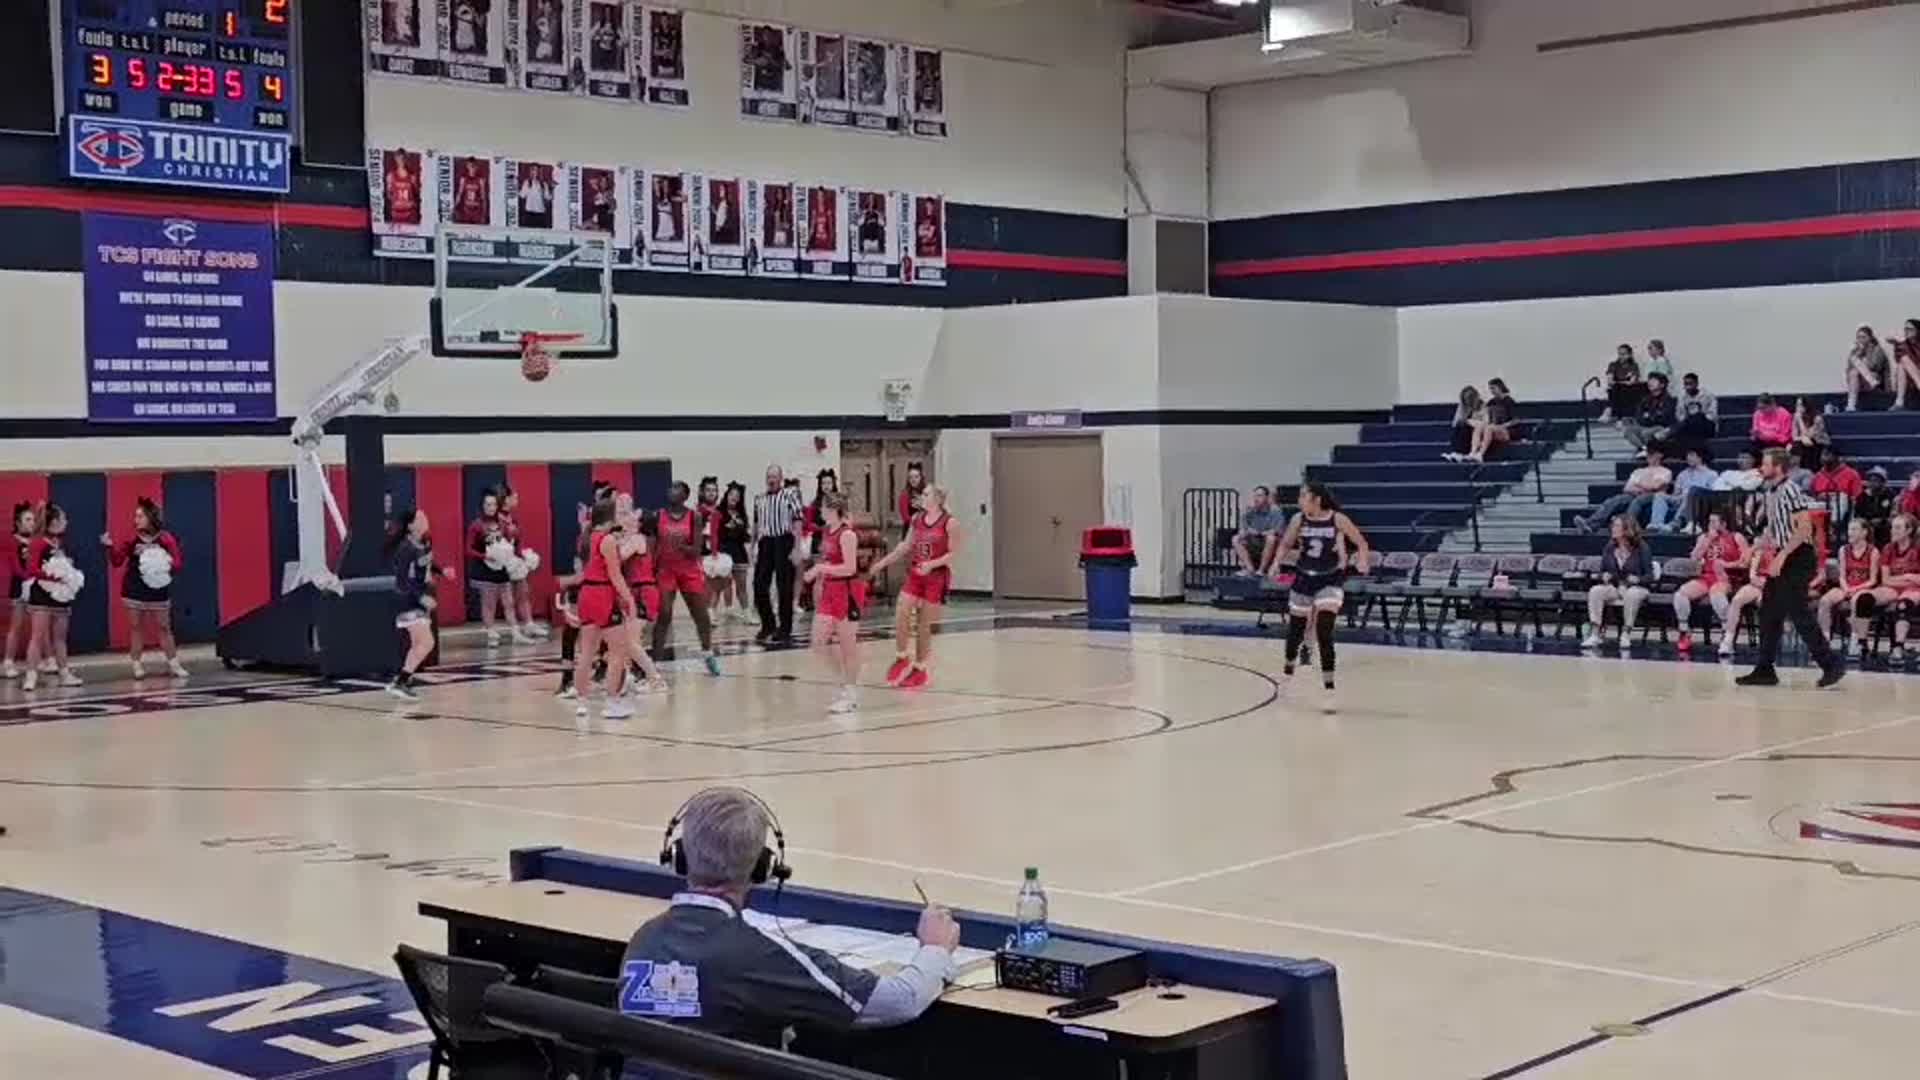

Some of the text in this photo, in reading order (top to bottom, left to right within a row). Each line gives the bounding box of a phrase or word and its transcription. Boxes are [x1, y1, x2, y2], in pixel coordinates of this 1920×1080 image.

[164, 11, 204, 28] period
[225, 11, 236, 36] 1
[78, 28, 113, 48] fouls
[163, 38, 206, 56] player
[93, 54, 112, 84] 3
[253, 49, 285, 67] fouls
[128, 59, 146, 87] 5
[224, 69, 243, 97] 5
[265, 76, 282, 100] 4
[84, 93, 113, 109] won
[169, 102, 203, 118] game
[258, 112, 284, 125] won
[149, 131, 283, 169] TRINITY
[163, 163, 269, 182] CHRISTIAN
[368, 148, 381, 189] SENIOR
[439, 156, 450, 193] SENIOR
[98, 245, 258, 269] TCS FIGHT SONG
